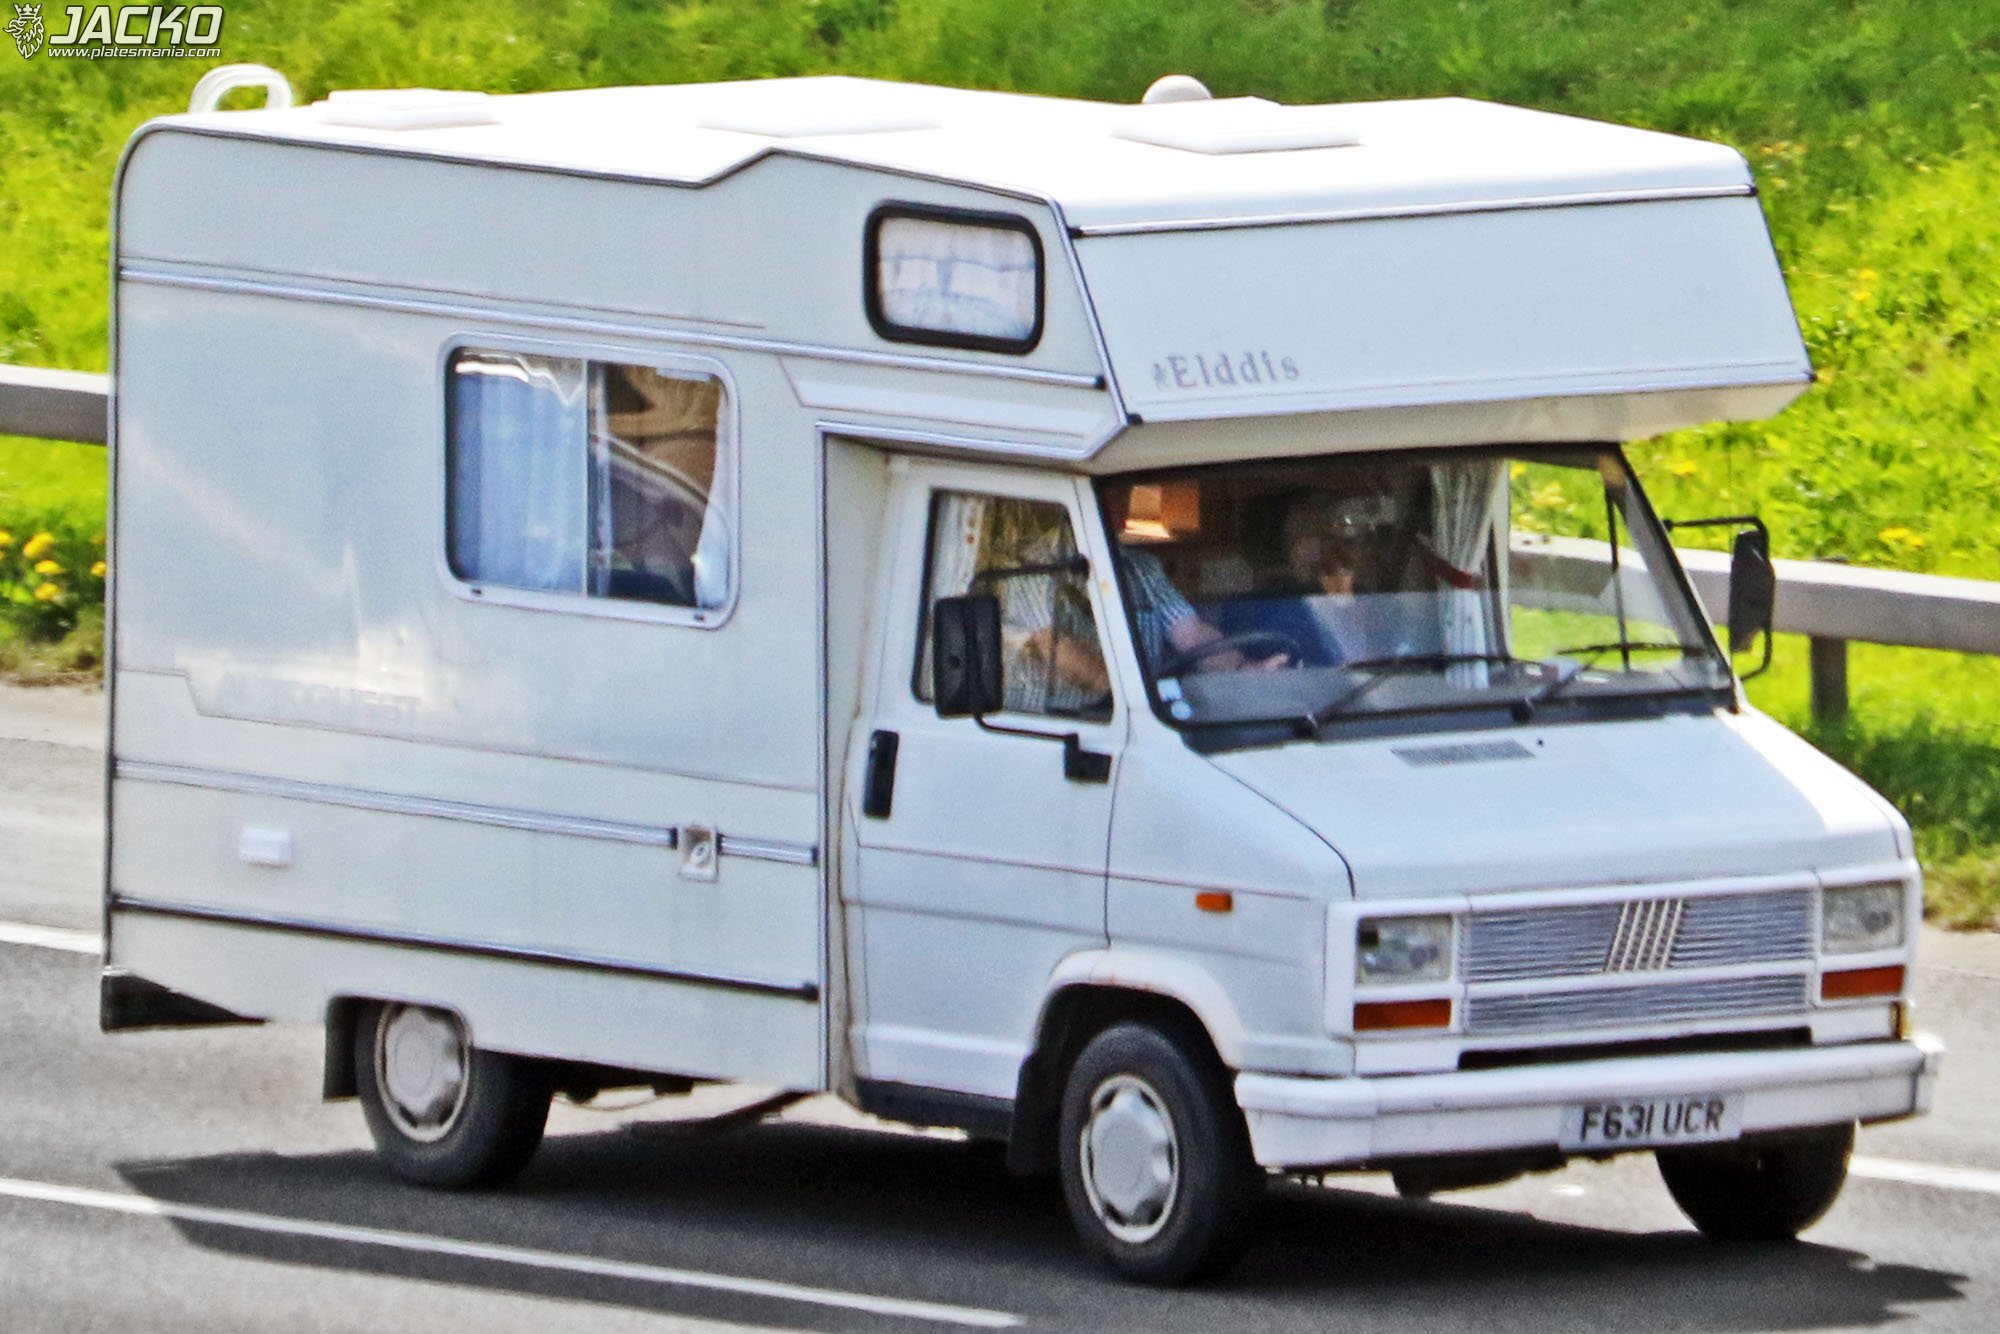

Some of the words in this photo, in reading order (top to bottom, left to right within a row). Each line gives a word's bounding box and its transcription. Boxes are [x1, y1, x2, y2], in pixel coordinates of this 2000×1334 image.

[1166, 350, 1300, 388] Elddis
[1580, 1103, 1655, 1142] F631
[1663, 1099, 1725, 1136] UCR
